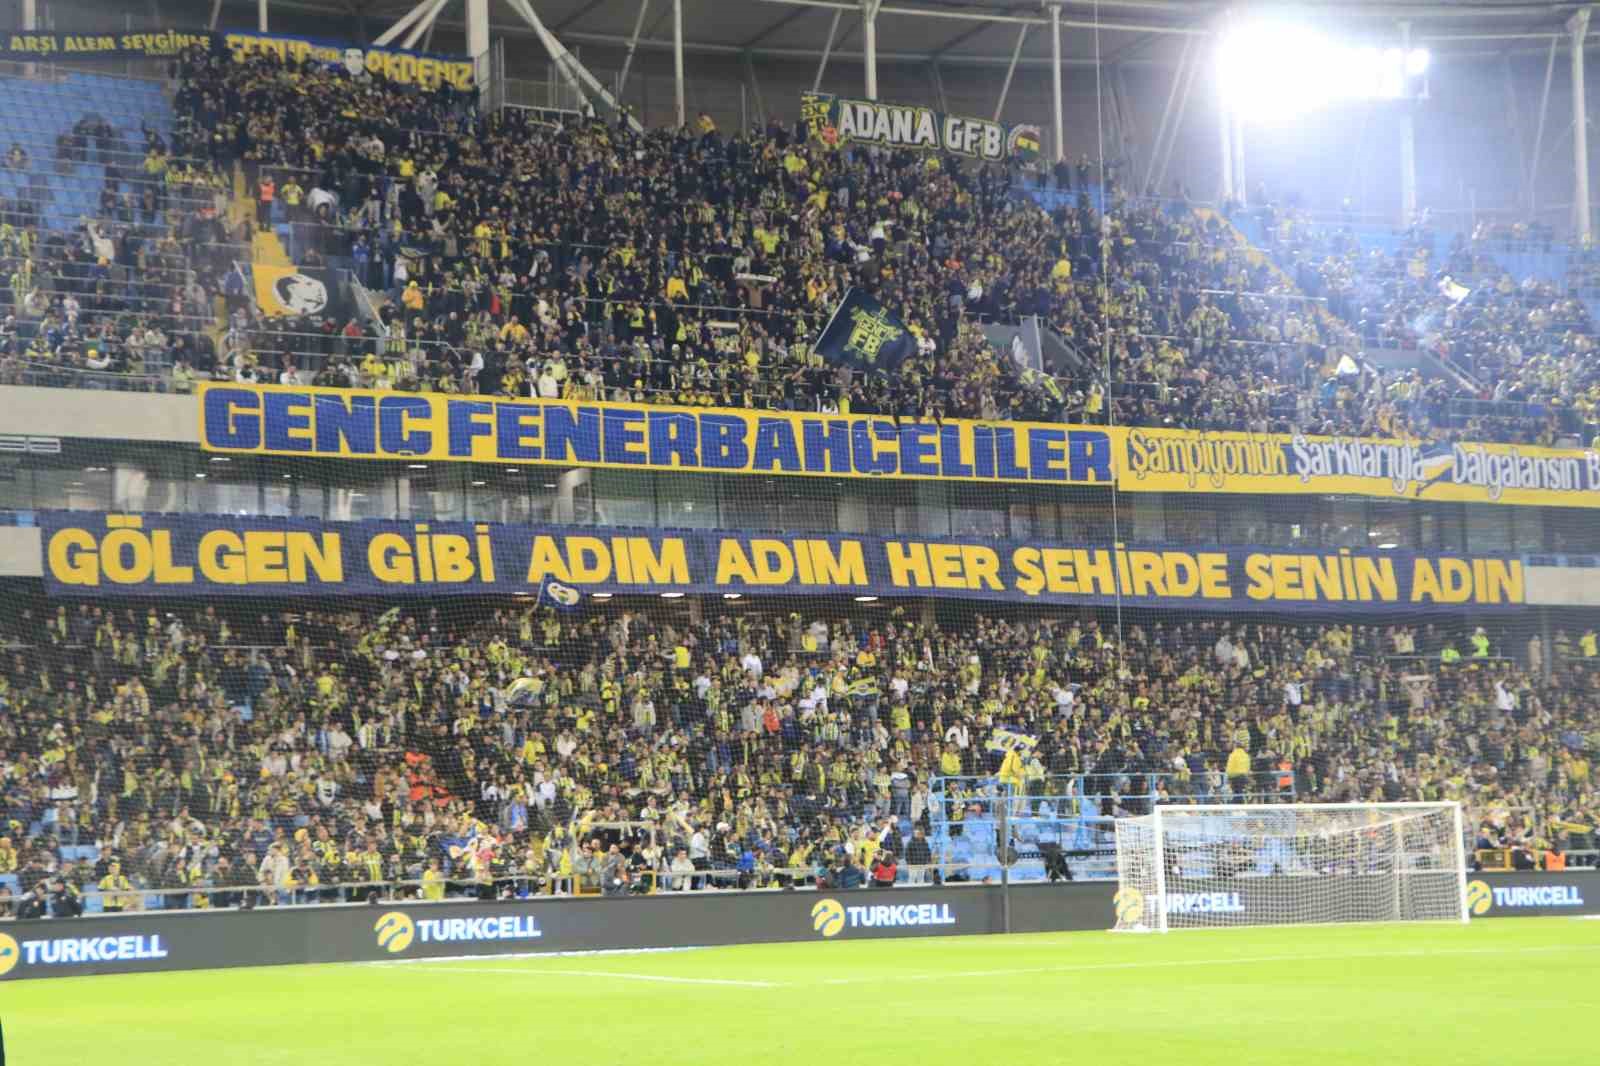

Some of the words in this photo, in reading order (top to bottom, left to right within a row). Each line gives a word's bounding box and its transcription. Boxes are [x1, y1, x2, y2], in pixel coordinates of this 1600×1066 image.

[63, 36, 116, 51] ALEM
[839, 103, 937, 145] ADANA
[946, 118, 1001, 156] GFB
[48, 514, 344, 586] GÖLGEN
[368, 524, 496, 586] GİBİ
[527, 535, 690, 585] ADIM
[716, 538, 869, 586] ADIM
[886, 542, 1006, 591] HER
[1012, 542, 1233, 599] ŞEHİRDE
[1245, 549, 1399, 602] SENİN
[1412, 559, 1525, 604] ADIN
[1494, 885, 1584, 906] TURKCELL
[847, 903, 956, 927] TURKCELL
[416, 916, 542, 942] TURKCELL
[23, 934, 168, 965] TURKCELL
